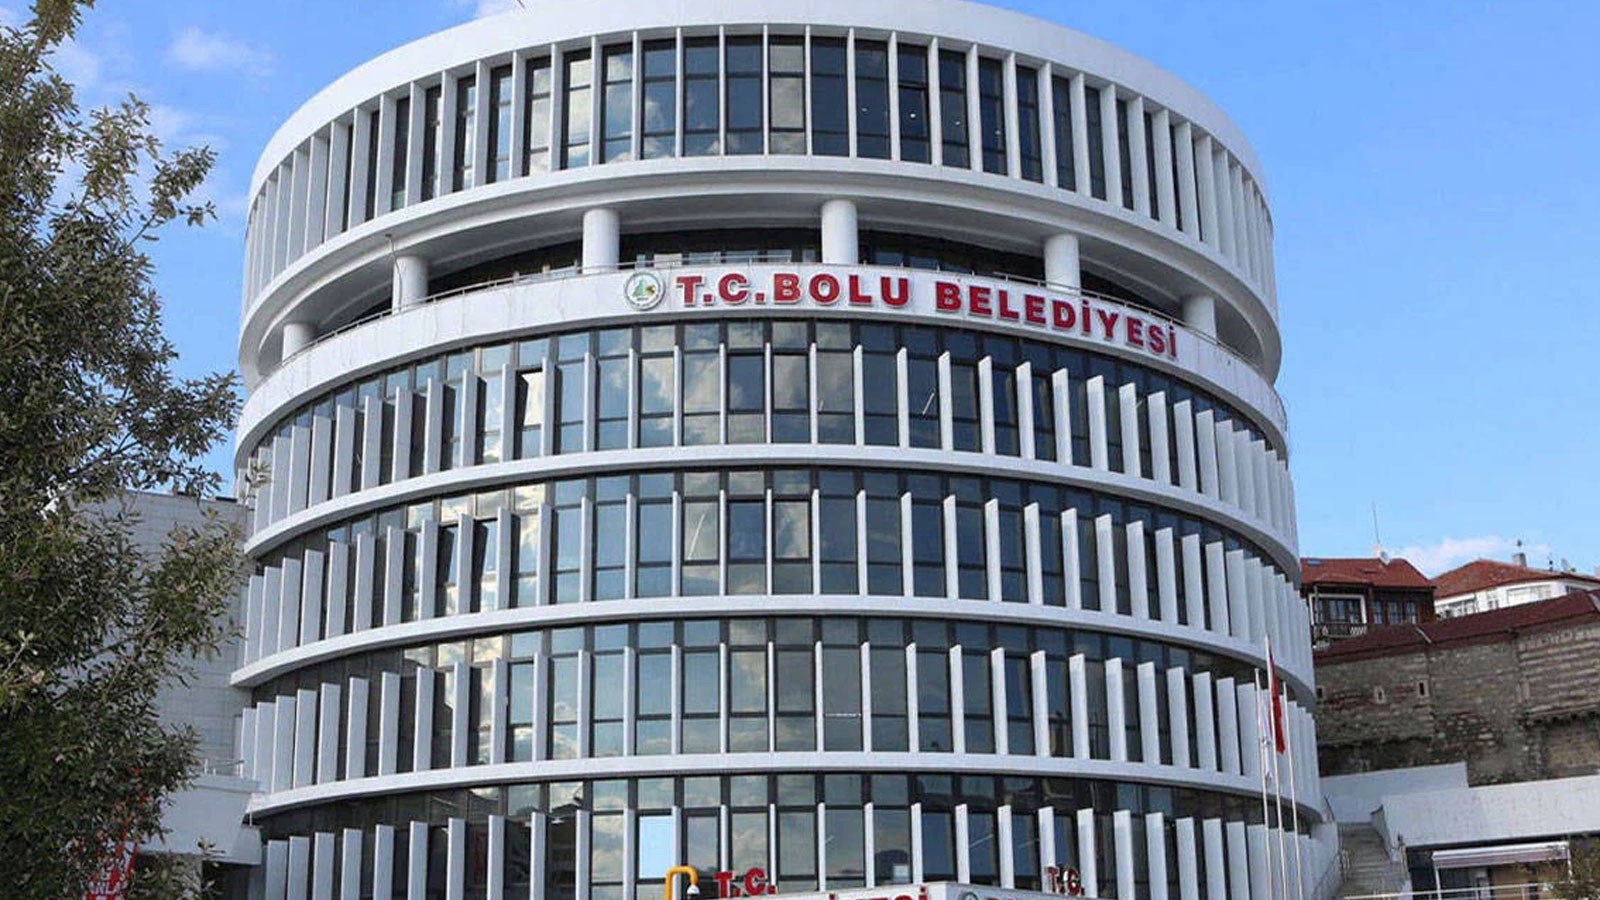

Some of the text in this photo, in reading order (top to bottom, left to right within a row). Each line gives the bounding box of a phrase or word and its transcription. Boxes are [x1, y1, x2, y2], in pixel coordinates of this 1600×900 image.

[935, 282, 1178, 359] BELEDİYESİ
[713, 867, 776, 898] T.C.
[1046, 866, 1086, 896] T.C.
